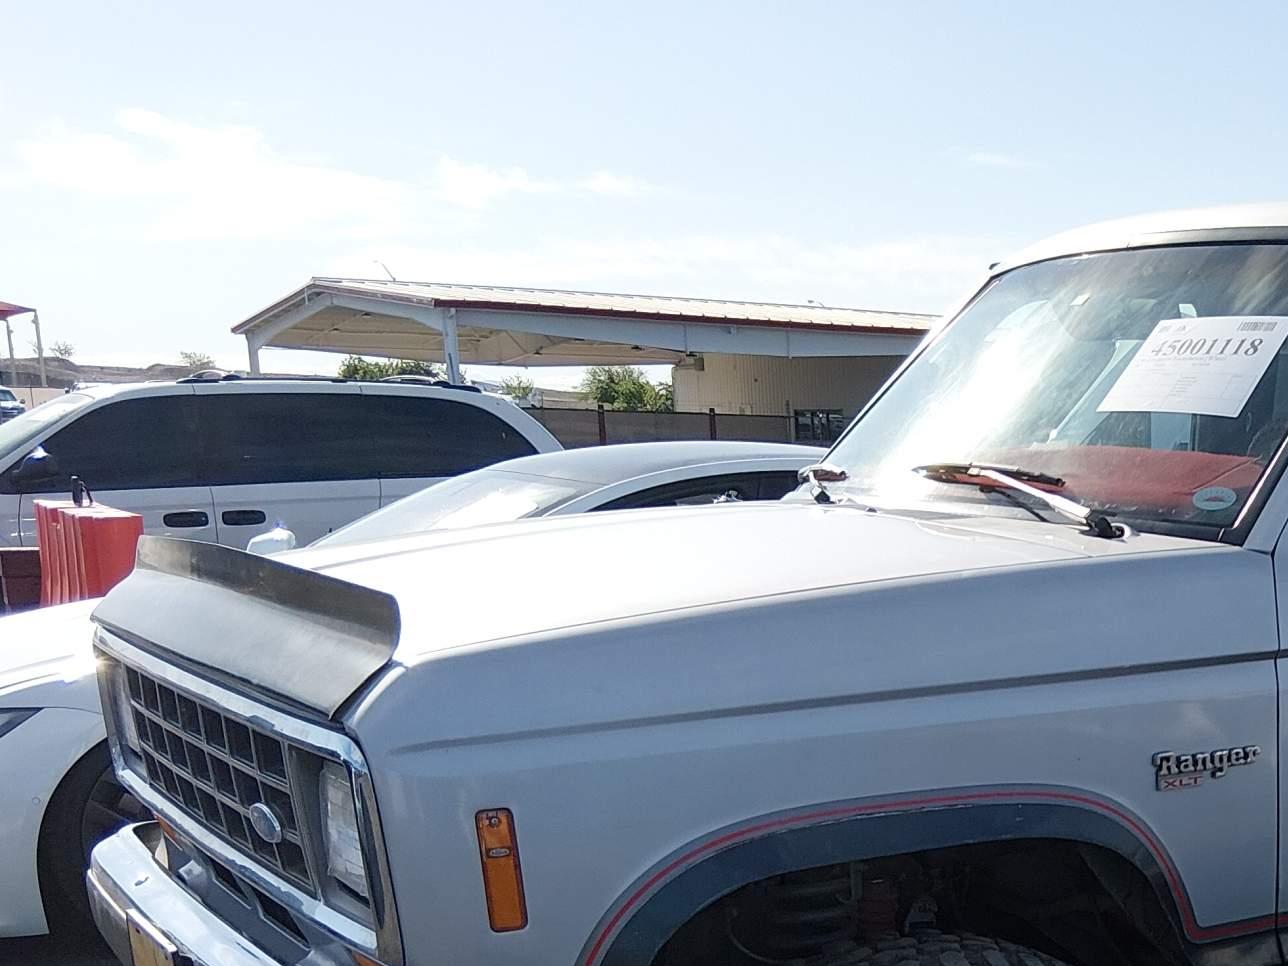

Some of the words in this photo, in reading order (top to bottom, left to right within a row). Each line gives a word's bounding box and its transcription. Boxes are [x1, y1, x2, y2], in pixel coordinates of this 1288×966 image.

[1151, 337, 1264, 357] 45001118
[1152, 745, 1262, 778] Ranger
[1162, 776, 1203, 790] XLT
